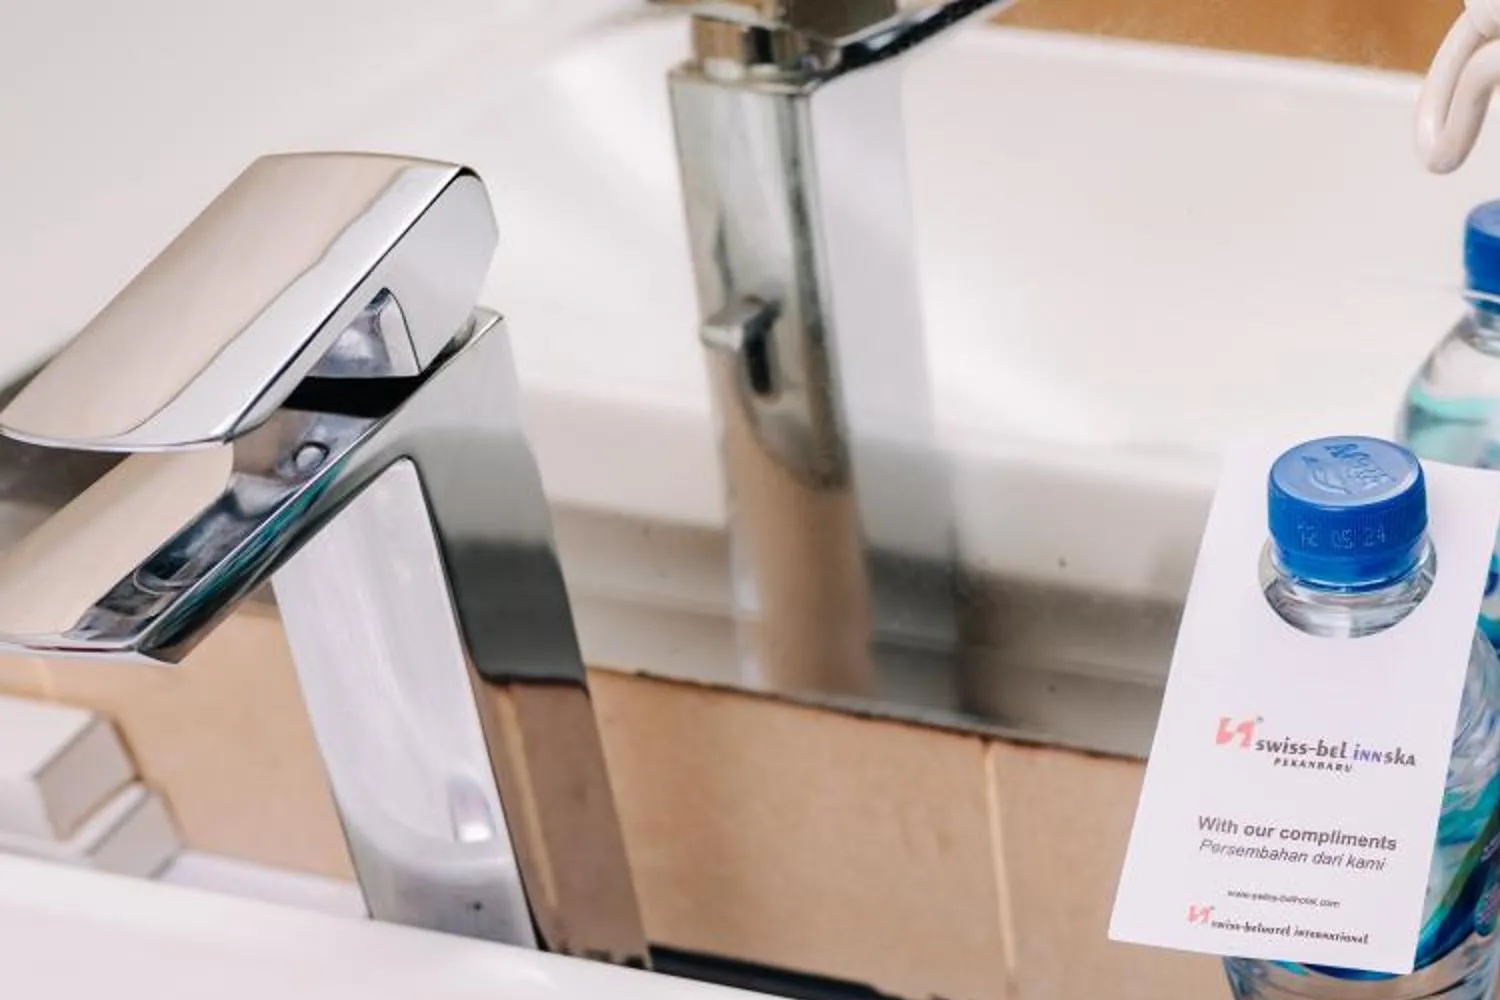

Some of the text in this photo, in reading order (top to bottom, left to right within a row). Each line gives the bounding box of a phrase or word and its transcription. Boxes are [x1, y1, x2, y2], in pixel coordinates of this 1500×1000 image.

[1273, 757, 1352, 772] PEKANBARU
[1198, 815, 1398, 851] With our compliments
[1199, 838, 1386, 871] Persembahan dari kami
